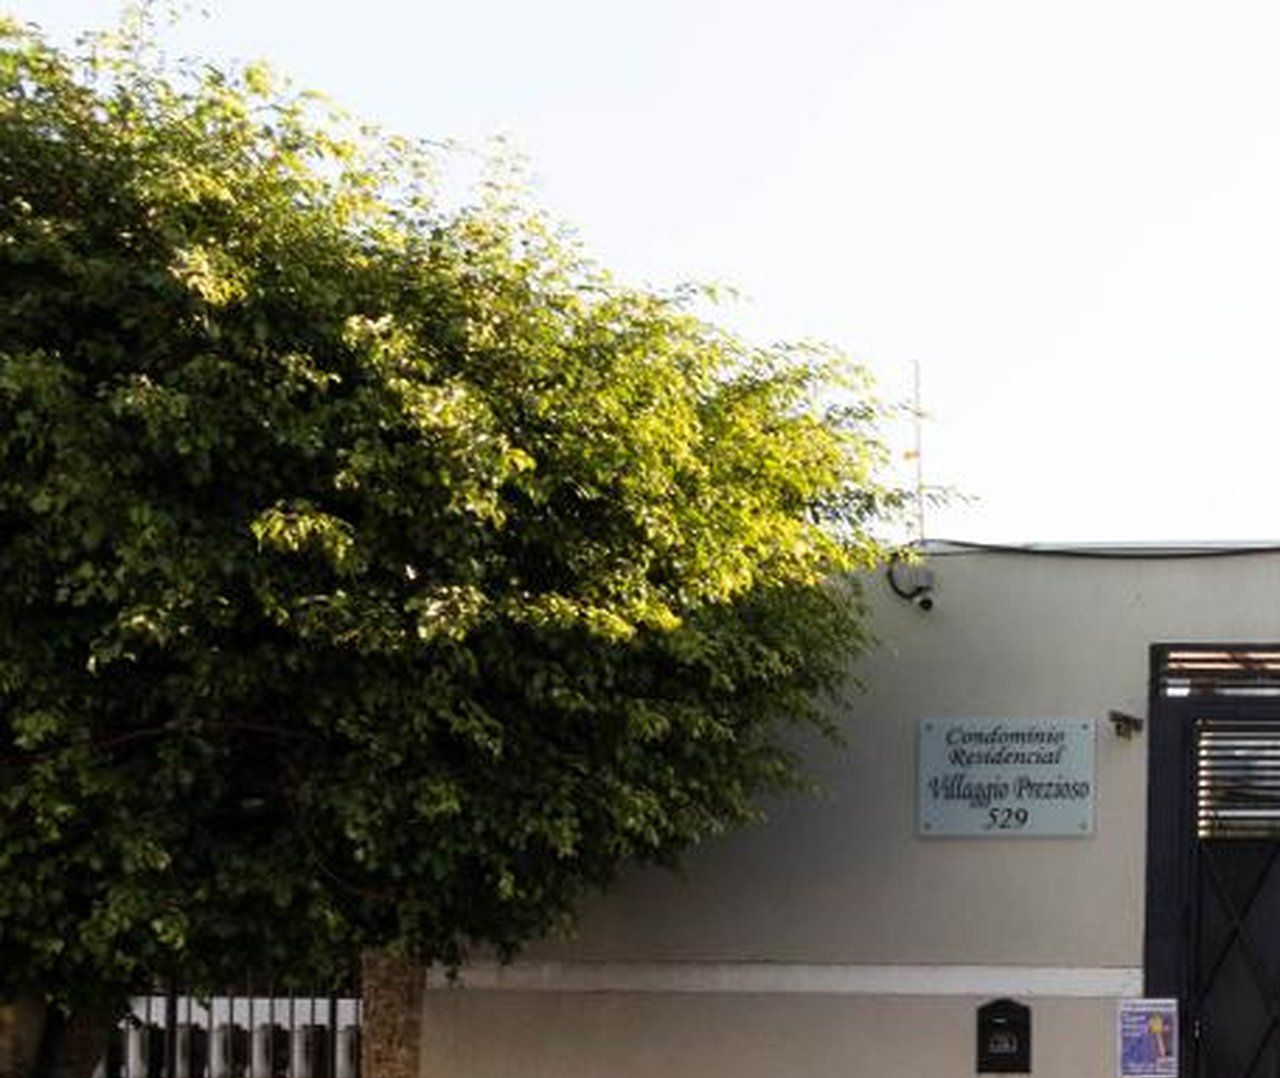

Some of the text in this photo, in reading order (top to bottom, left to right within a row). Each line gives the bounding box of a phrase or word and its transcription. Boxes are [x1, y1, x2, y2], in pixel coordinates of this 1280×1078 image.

[948, 745, 1068, 767] Residencial
[928, 774, 1091, 808] Villaggio Prezioso
[984, 808, 1029, 829] 529
